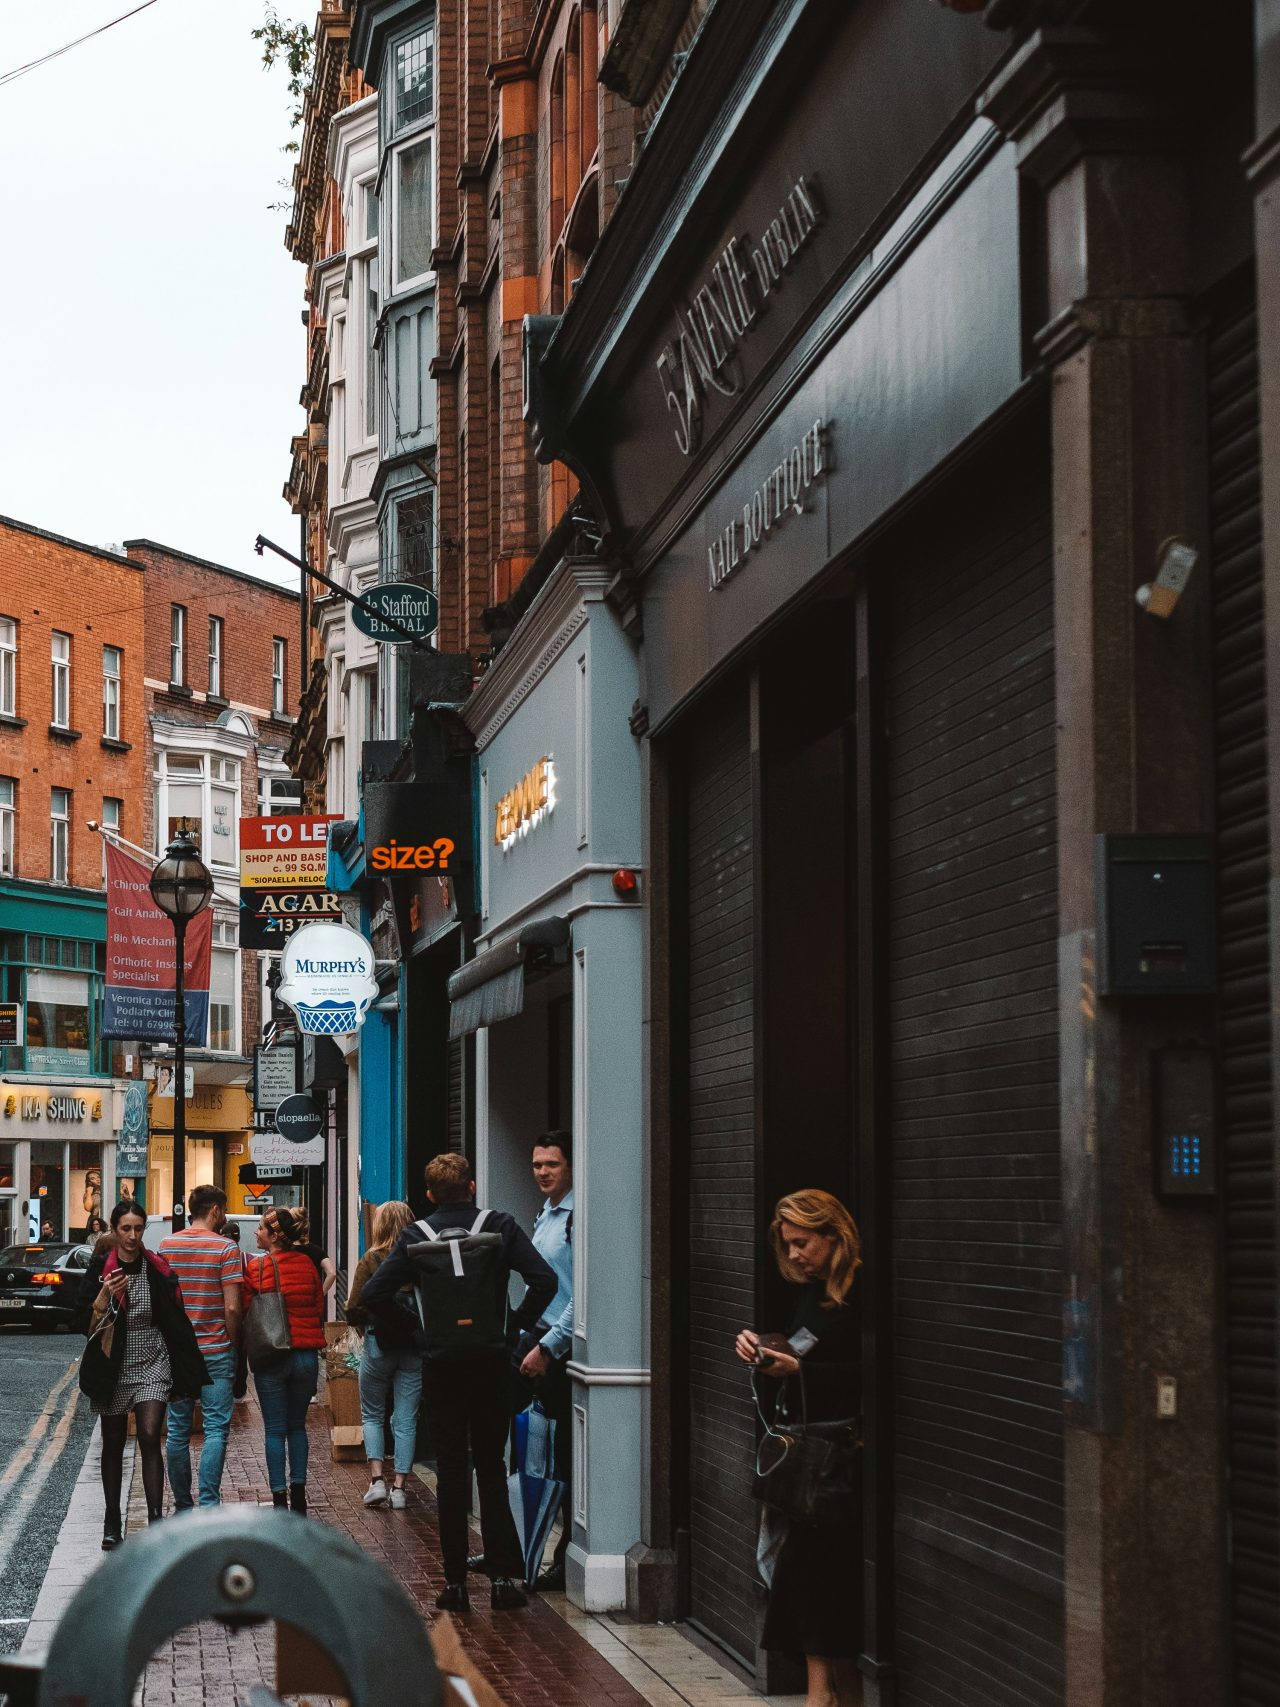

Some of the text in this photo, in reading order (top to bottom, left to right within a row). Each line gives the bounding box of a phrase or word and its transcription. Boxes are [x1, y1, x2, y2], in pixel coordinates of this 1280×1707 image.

[751, 175, 817, 298] DUBLIN
[708, 418, 823, 592] NAIL BOUTIQUE
[381, 594, 430, 617] Stafford
[261, 822, 329, 843] TO LE
[245, 852, 326, 863] SHOP AND BASE
[371, 837, 455, 870] size?
[285, 864, 297, 872] 99
[258, 893, 341, 913] AGAR
[114, 906, 168, 919] Gait Analys
[113, 933, 128, 943] Bio
[112, 955, 193, 969] Orthotic Insoes
[295, 957, 366, 974] MURPHY'S
[112, 969, 160, 982] Specialist
[111, 993, 190, 1007] Veronica Danis
[116, 1005, 155, 1018] Podiatry
[113, 1017, 174, 1030] Tel: 01 67996
[22, 1096, 87, 1119] KA SHING
[257, 1167, 292, 1176] TATTOO
